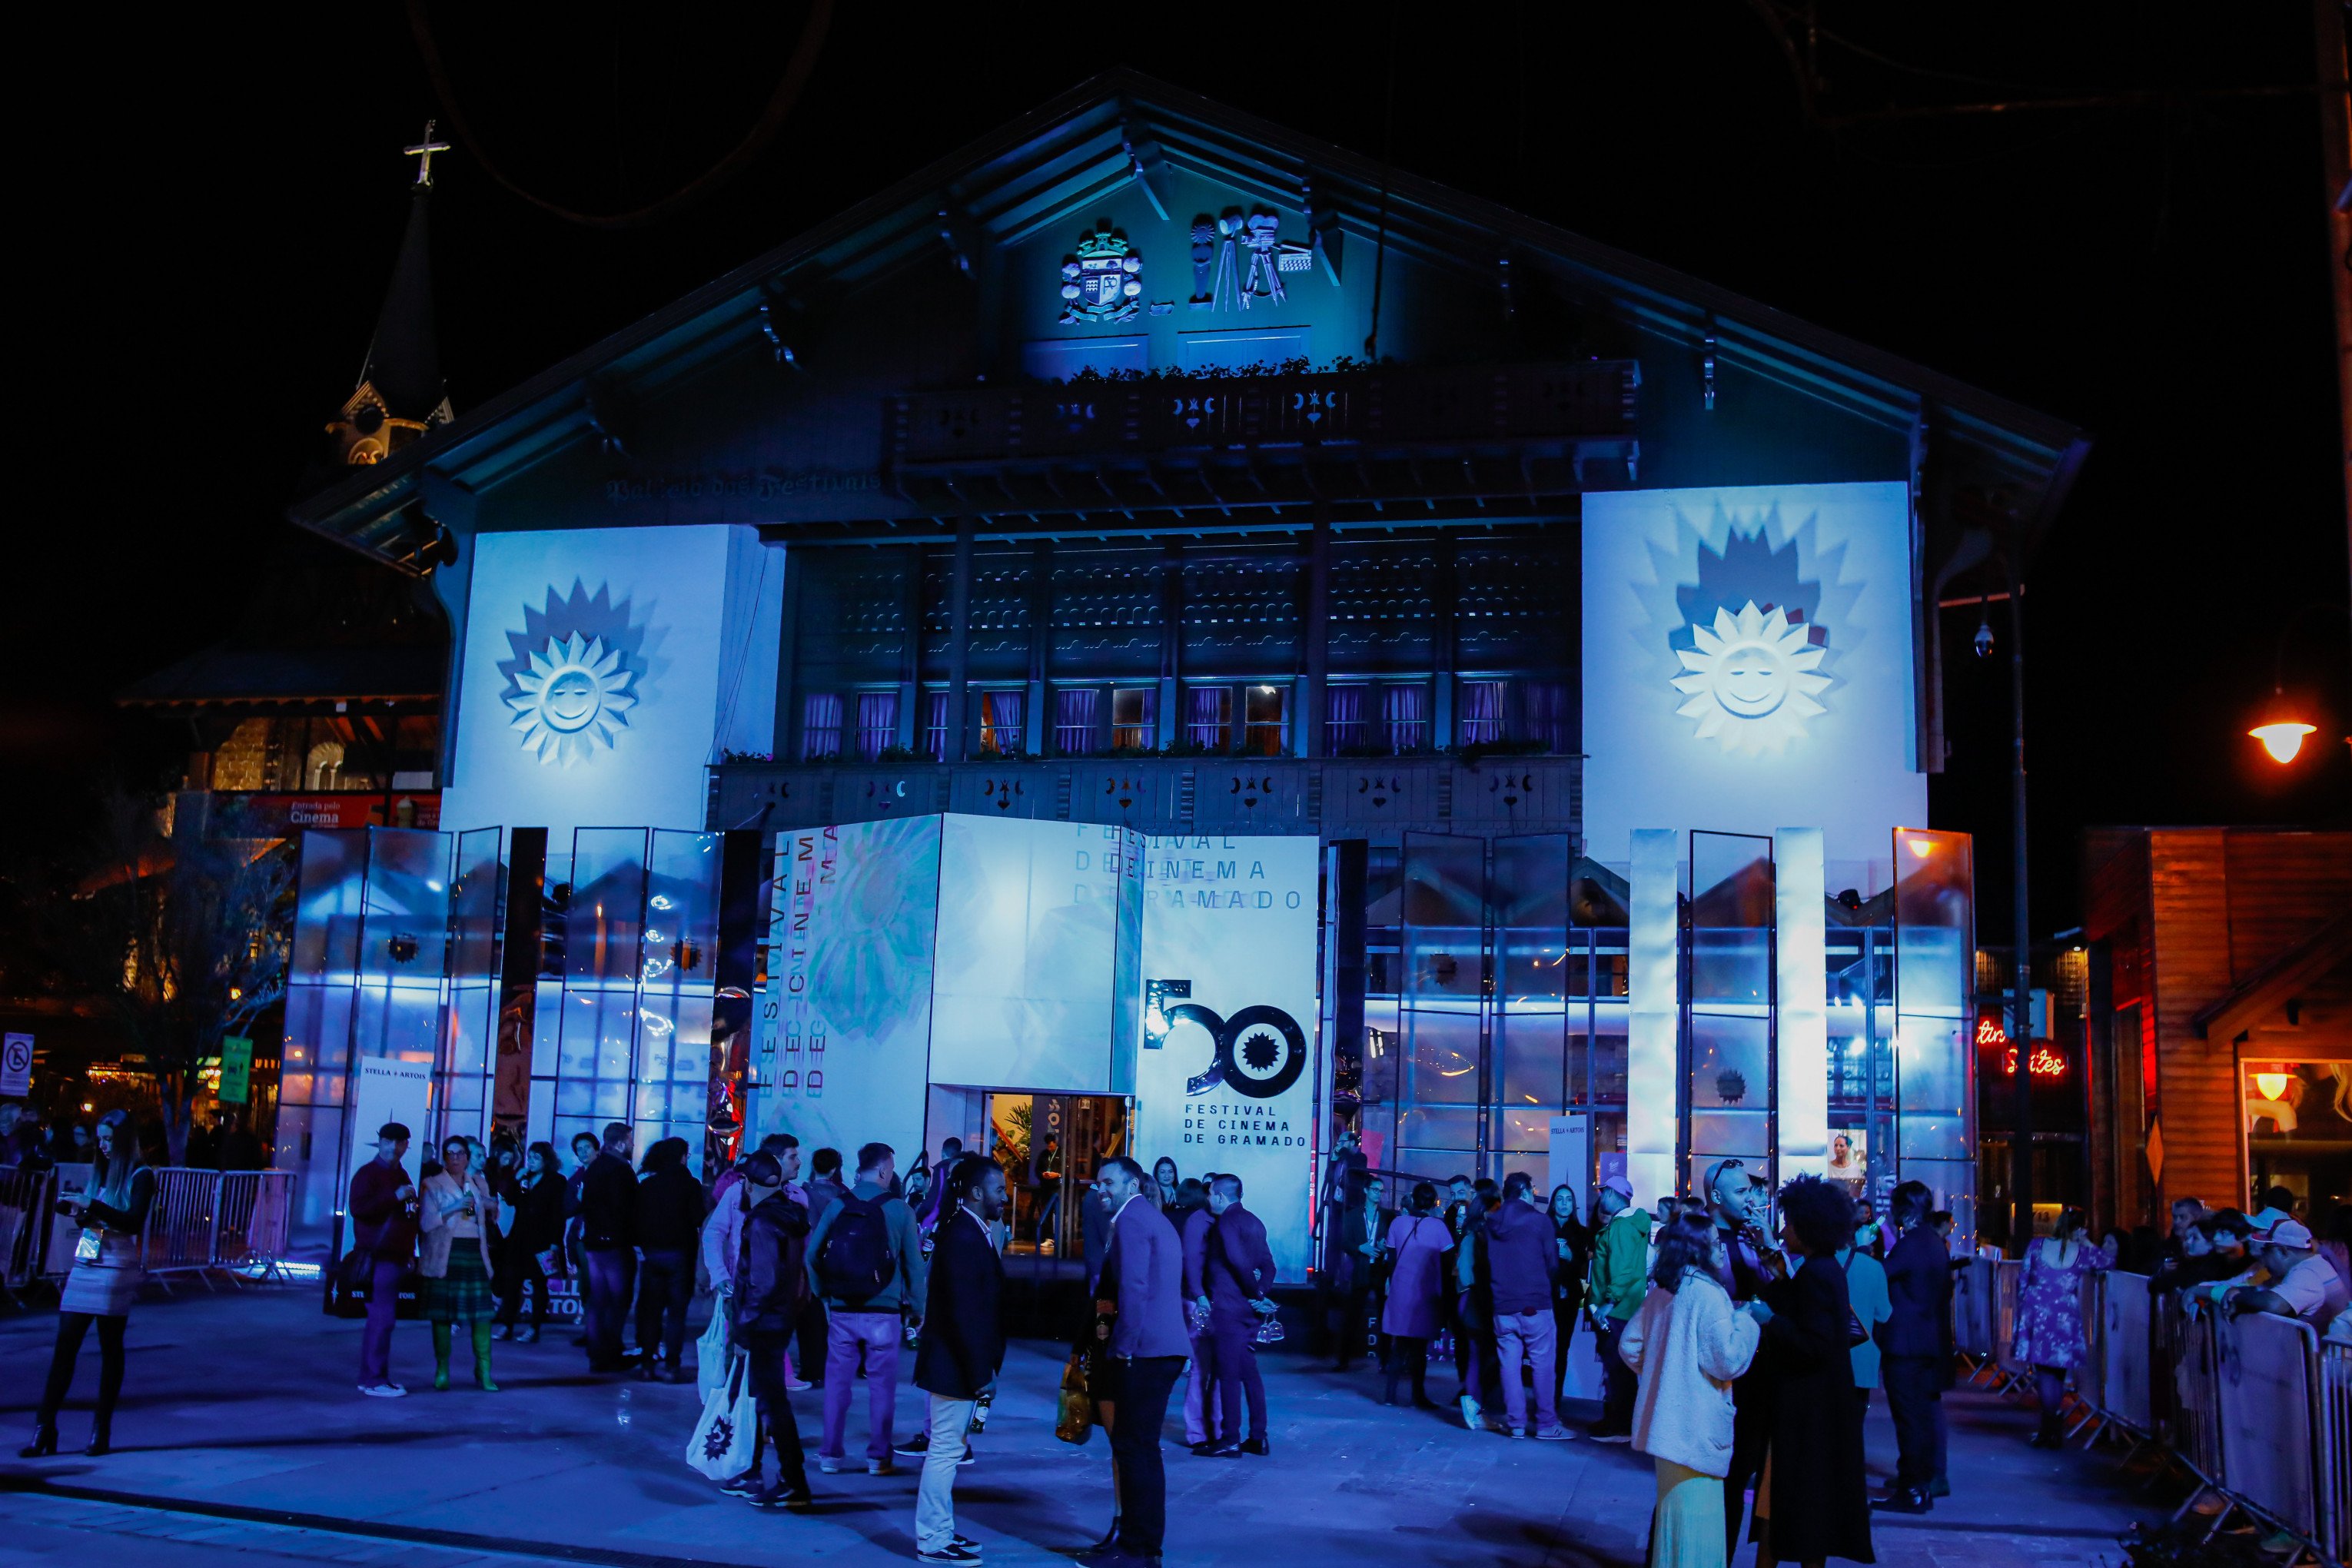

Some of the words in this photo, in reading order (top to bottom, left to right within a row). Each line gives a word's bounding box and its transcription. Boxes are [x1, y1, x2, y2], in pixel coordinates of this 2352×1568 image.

[291, 811, 339, 823] Cinema
[1144, 978, 1307, 1098] 50
[365, 1068, 391, 1076] STELLA
[400, 1071, 427, 1080] ARTOIS
[1185, 1104, 1276, 1117] FESTIVAL
[1184, 1118, 1205, 1129] DE
[1218, 1119, 1289, 1131] CINEMA
[1184, 1133, 1205, 1144] DE
[1218, 1134, 1306, 1147] GRAMADO
